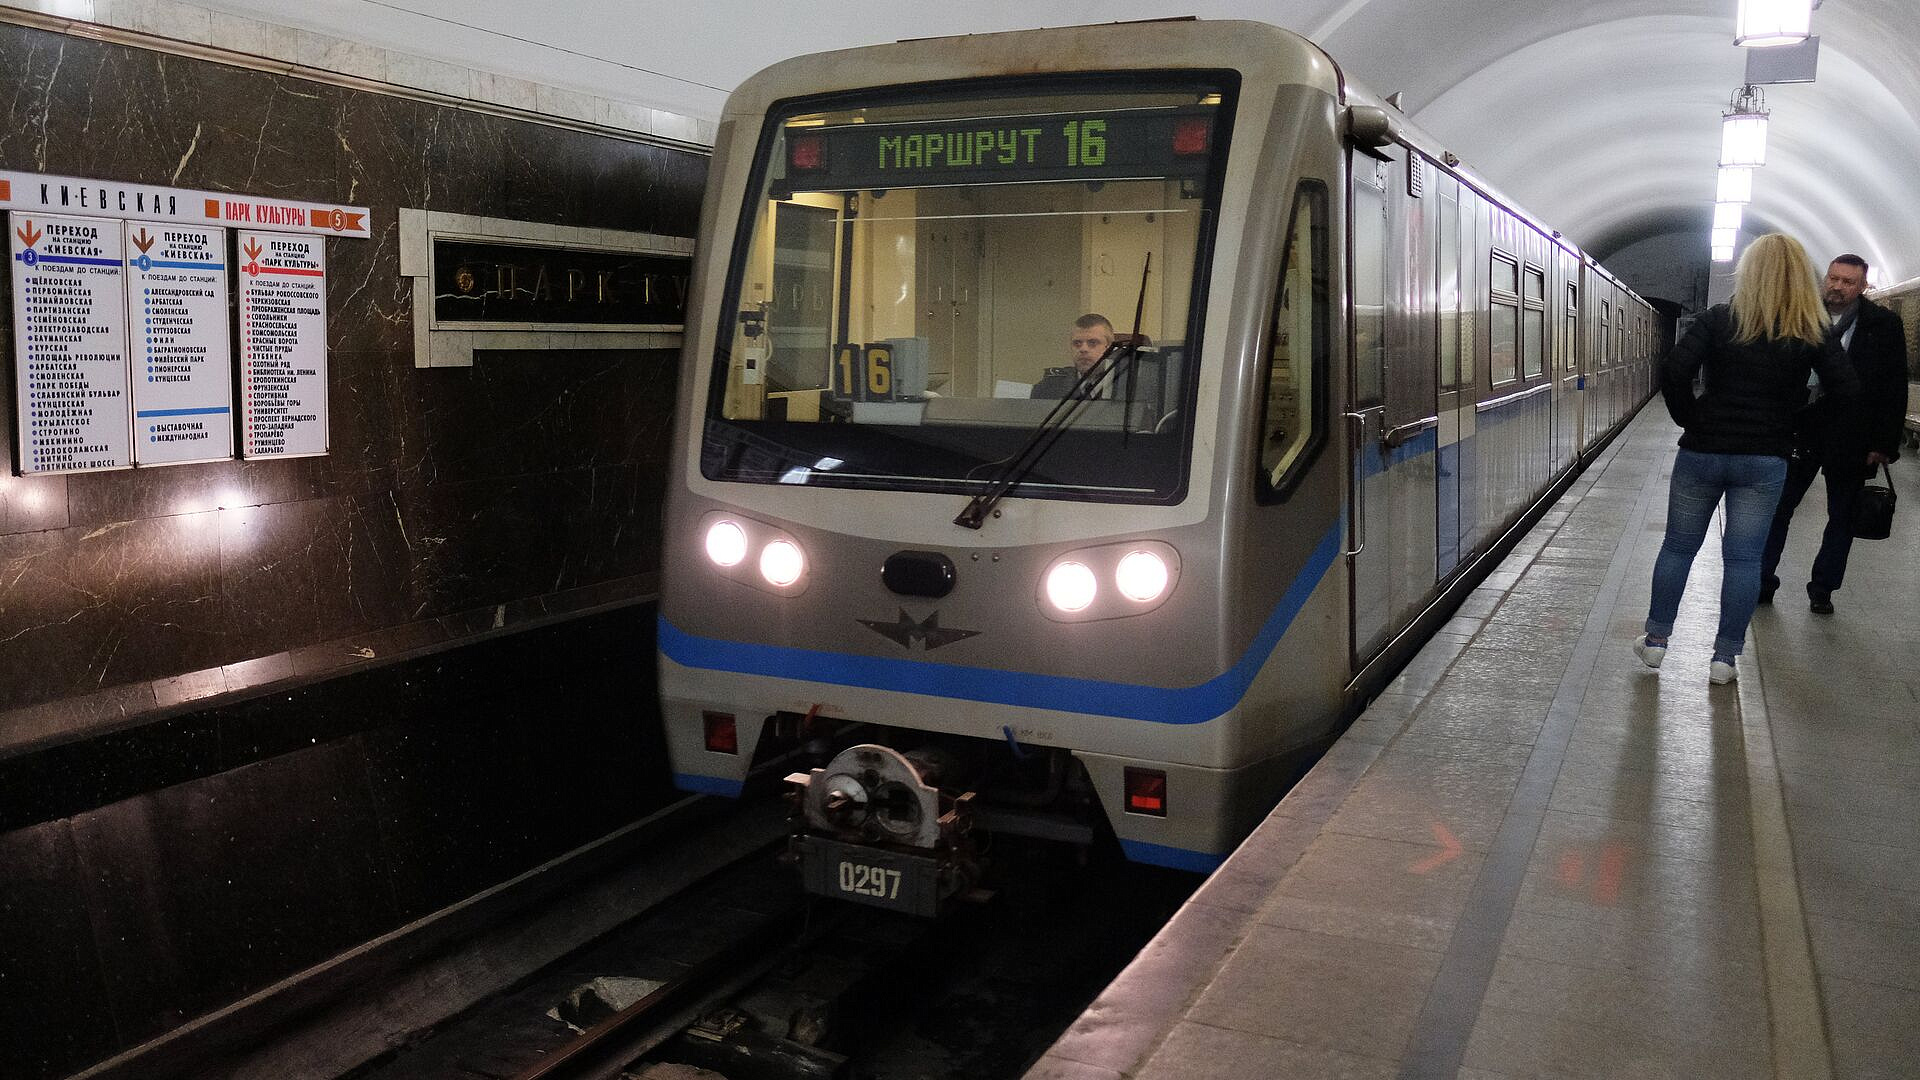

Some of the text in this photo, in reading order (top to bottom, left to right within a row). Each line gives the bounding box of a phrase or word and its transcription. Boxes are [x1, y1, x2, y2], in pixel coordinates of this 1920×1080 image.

[879, 120, 1106, 168] МАРШРУТ 16
[41, 184, 176, 215] КИЕВСКАЯ
[226, 202, 306, 226] ПАРК КУЛЬТУРЫ
[336, 214, 340, 226] 5
[47, 225, 97, 239] ПЕРЕХОД
[165, 232, 207, 245] ПЕРЕХОД
[271, 242, 309, 253] ПЕРЕХОД
[28, 252, 32, 260] 3
[32, 277, 82, 286] ЩЁЛКОВСКАЯ
[496, 264, 618, 303] ПАРК
[33, 287, 91, 296] ПЕРВОМАЙСКАЯ
[277, 291, 318, 299] РОКОССОВСКОГО
[33, 296, 92, 305] ИЗМАЙЛОВСКАЯ
[34, 315, 86, 324] СЕМЁНОВСКАЯ
[840, 349, 890, 394] 16
[37, 390, 85, 398] СЛАВЯНСКИЙ
[38, 401, 84, 409] КУНЦЕВСКАЯ
[38, 408, 92, 418] МОЛОДЁЖНАЯ
[157, 423, 202, 432] ВЫСТАВОЧНАЯ
[157, 432, 208, 441] МЕЖДУНАРОДНАЯ
[40, 437, 83, 446] МЯКИНИНО
[40, 445, 108, 455] ВОЛОКОЛАМСКАЯ
[41, 462, 86, 470] ПЯТНИЦКОЕ
[840, 862, 902, 899] 0297
